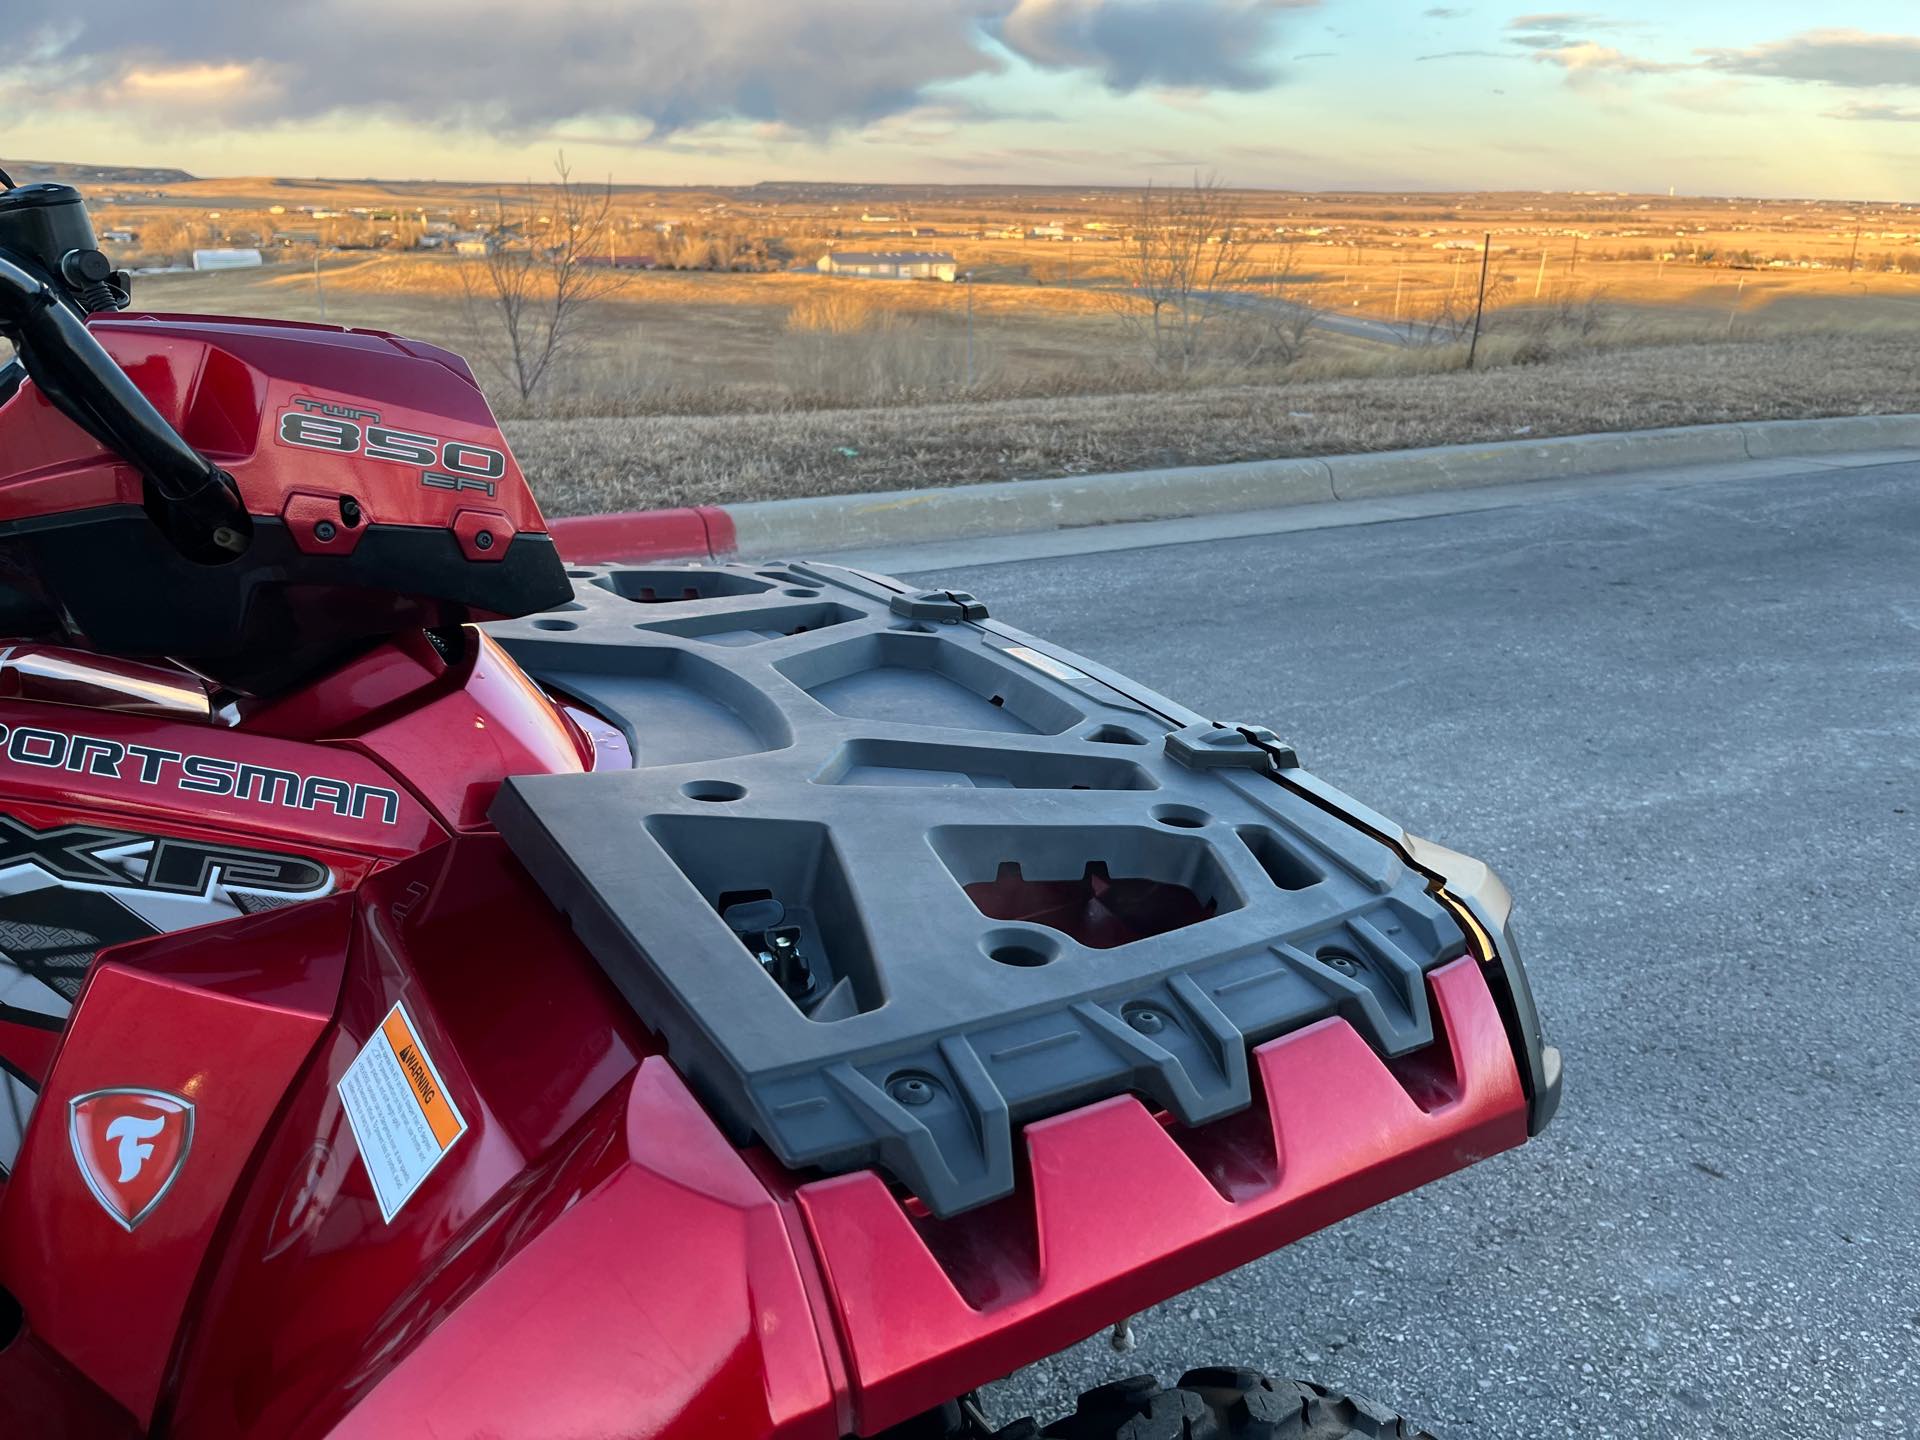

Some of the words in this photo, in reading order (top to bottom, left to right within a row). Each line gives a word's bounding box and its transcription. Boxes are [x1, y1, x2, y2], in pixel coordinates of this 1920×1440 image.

[280, 412, 505, 479] 850
[422, 471, 496, 497] EFI
[0, 723, 400, 825] ORTSMAN
[406, 1051, 436, 1105] WARNING
